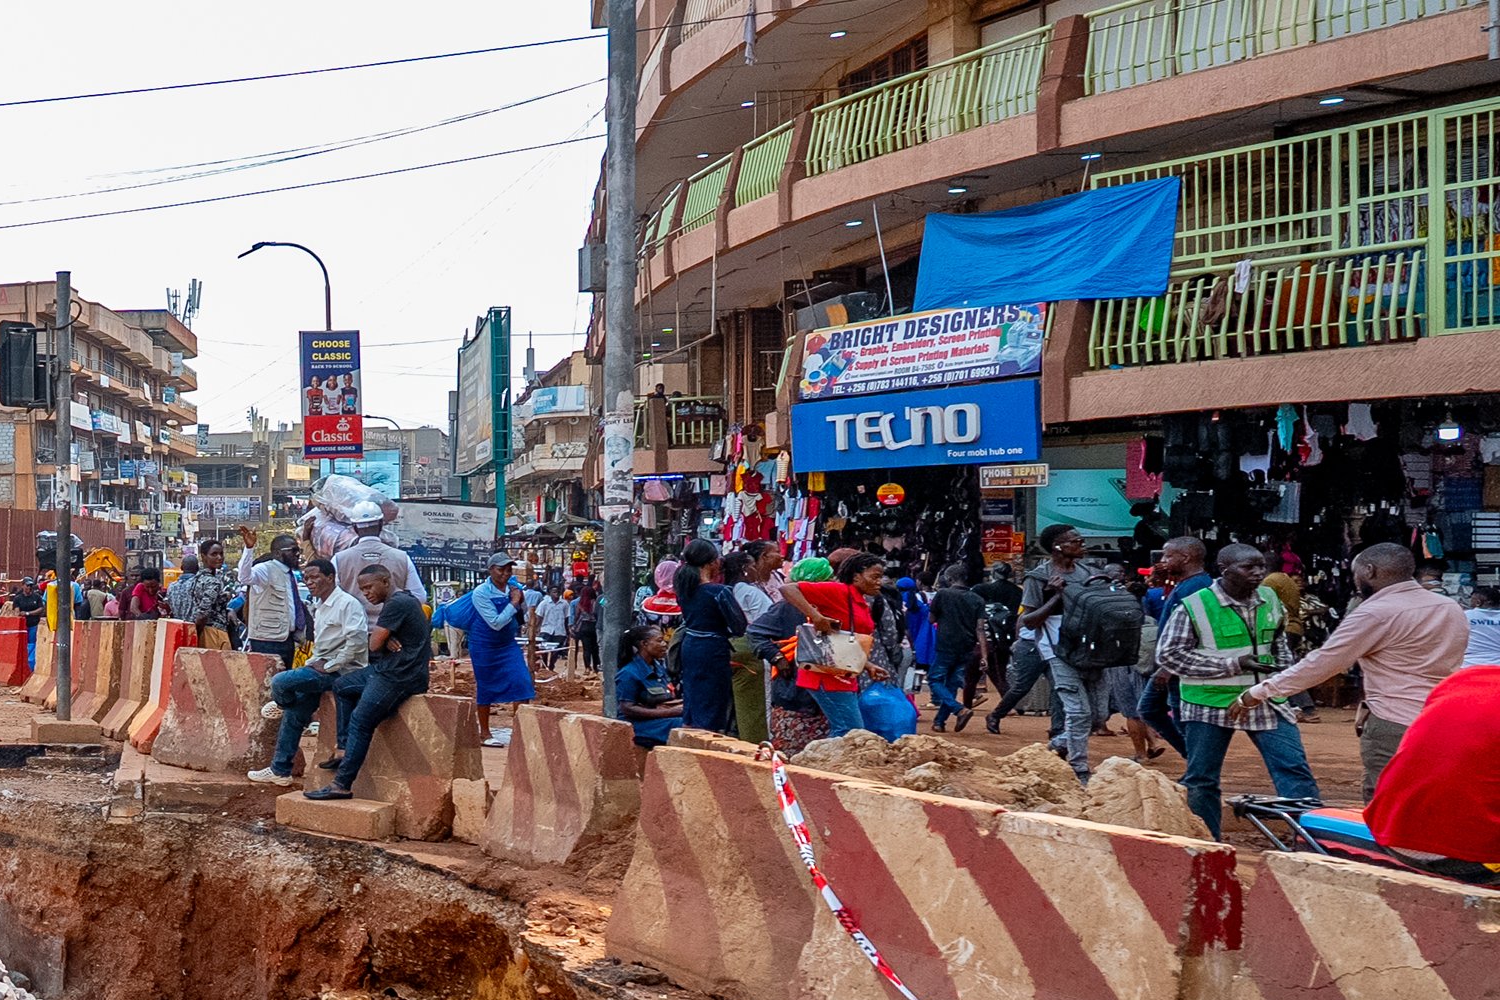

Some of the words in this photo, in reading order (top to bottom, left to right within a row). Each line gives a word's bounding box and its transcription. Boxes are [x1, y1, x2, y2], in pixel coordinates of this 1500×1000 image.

[829, 322, 899, 351] BRIGHT
[903, 304, 1021, 340] DESIGNERS
[938, 333, 966, 345] Screen
[968, 327, 1002, 340] Printing
[312, 340, 351, 348] CHOOSE
[311, 352, 351, 361] CLASSIC
[854, 359, 879, 371] Supply
[880, 358, 888, 367] of
[889, 355, 916, 366] Screen
[917, 348, 949, 361] Printing
[950, 343, 990, 357] Materials
[832, 386, 846, 395] TEL:
[846, 382, 866, 393] +256
[921, 373, 943, 385] +256
[943, 369, 969, 382] (0)701
[970, 364, 1000, 379] 699241
[825, 402, 981, 451] TECNO
[311, 430, 353, 442] Classic
[947, 449, 966, 458] Four
[967, 448, 988, 457] mobi
[988, 447, 1006, 456] hub
[1006, 447, 1023, 455] one
[983, 468, 1012, 478] PHONE
[1013, 466, 1045, 477] REPAIR
